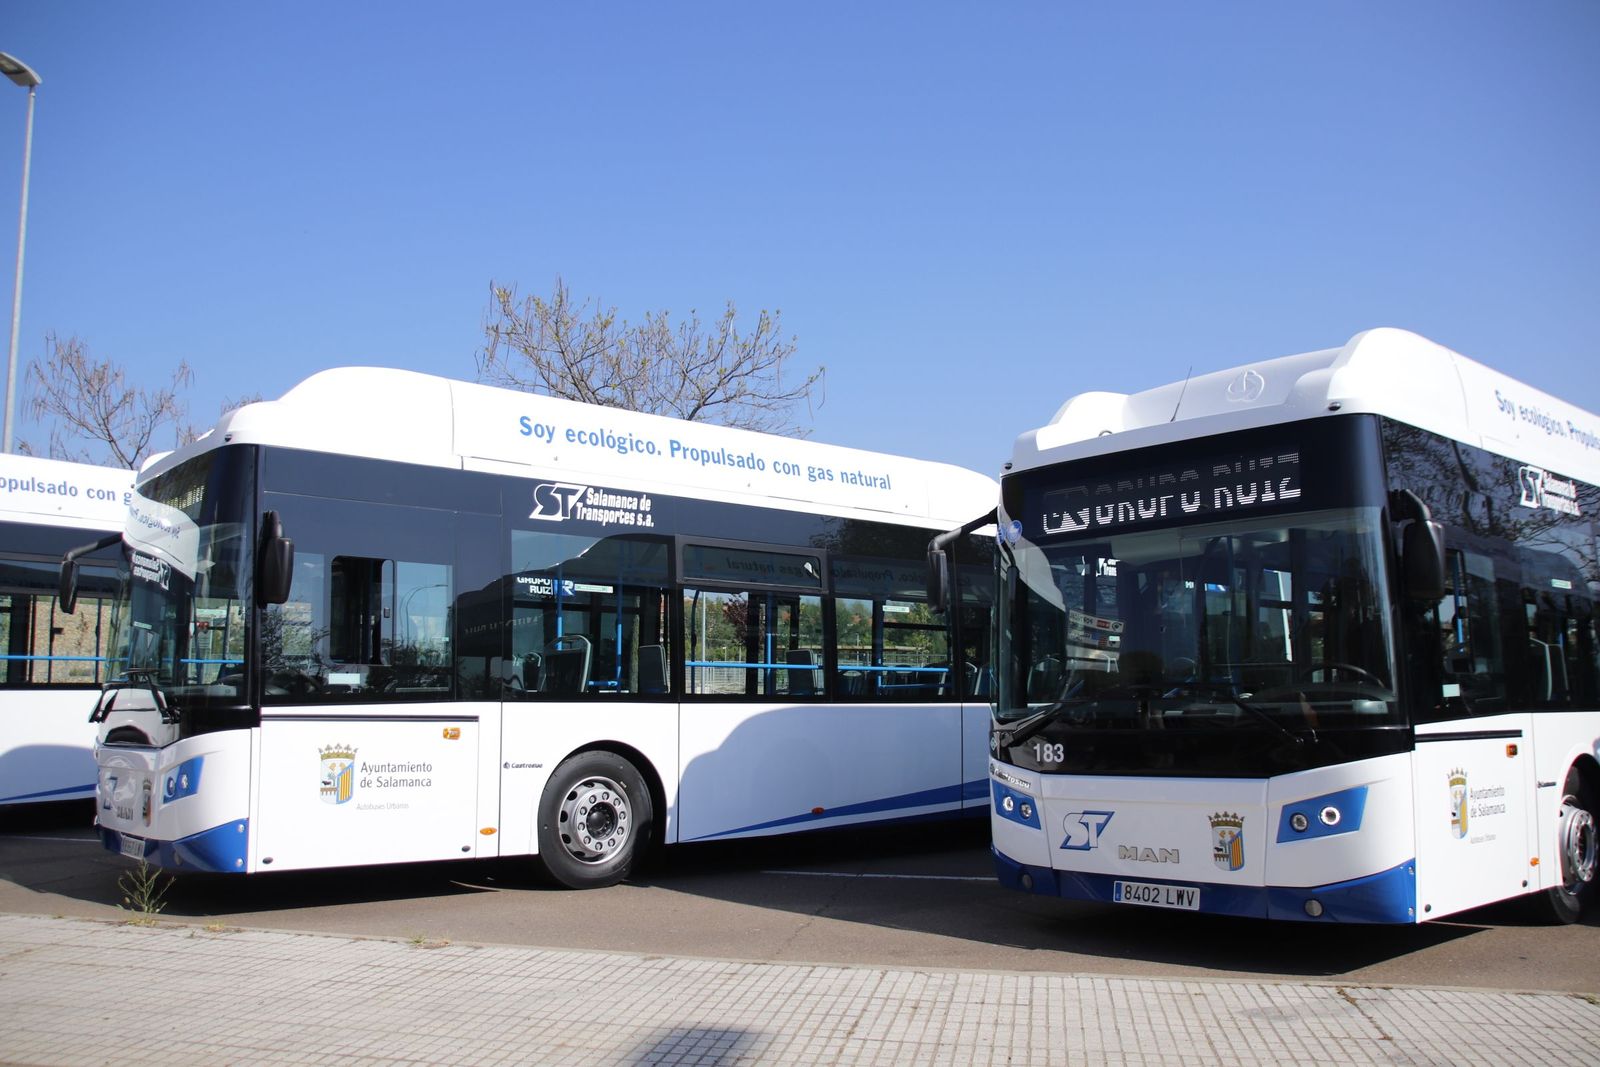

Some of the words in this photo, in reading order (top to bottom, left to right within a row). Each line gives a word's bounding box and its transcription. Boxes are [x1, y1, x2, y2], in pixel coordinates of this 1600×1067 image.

[519, 415, 555, 444] Soy
[565, 427, 662, 455] ecológico.
[669, 439, 765, 471] Propulsado
[773, 460, 801, 476] con
[807, 465, 834, 482] gas
[840, 470, 892, 490] natural
[86, 487, 116, 501] con
[529, 482, 588, 521] ST
[586, 487, 638, 508] Salamanca
[640, 494, 651, 511] de
[576, 501, 636, 526] Transportes
[530, 585, 552, 595] RUIZ
[1033, 743, 1064, 763] 183
[360, 762, 433, 775] Ayuntamiento
[360, 776, 372, 788] de
[376, 776, 432, 788] Salamanca
[1060, 810, 1115, 850] ST
[1118, 844, 1180, 864] MAN
[1124, 884, 1160, 904] 8402
[1166, 888, 1195, 907] LWV
